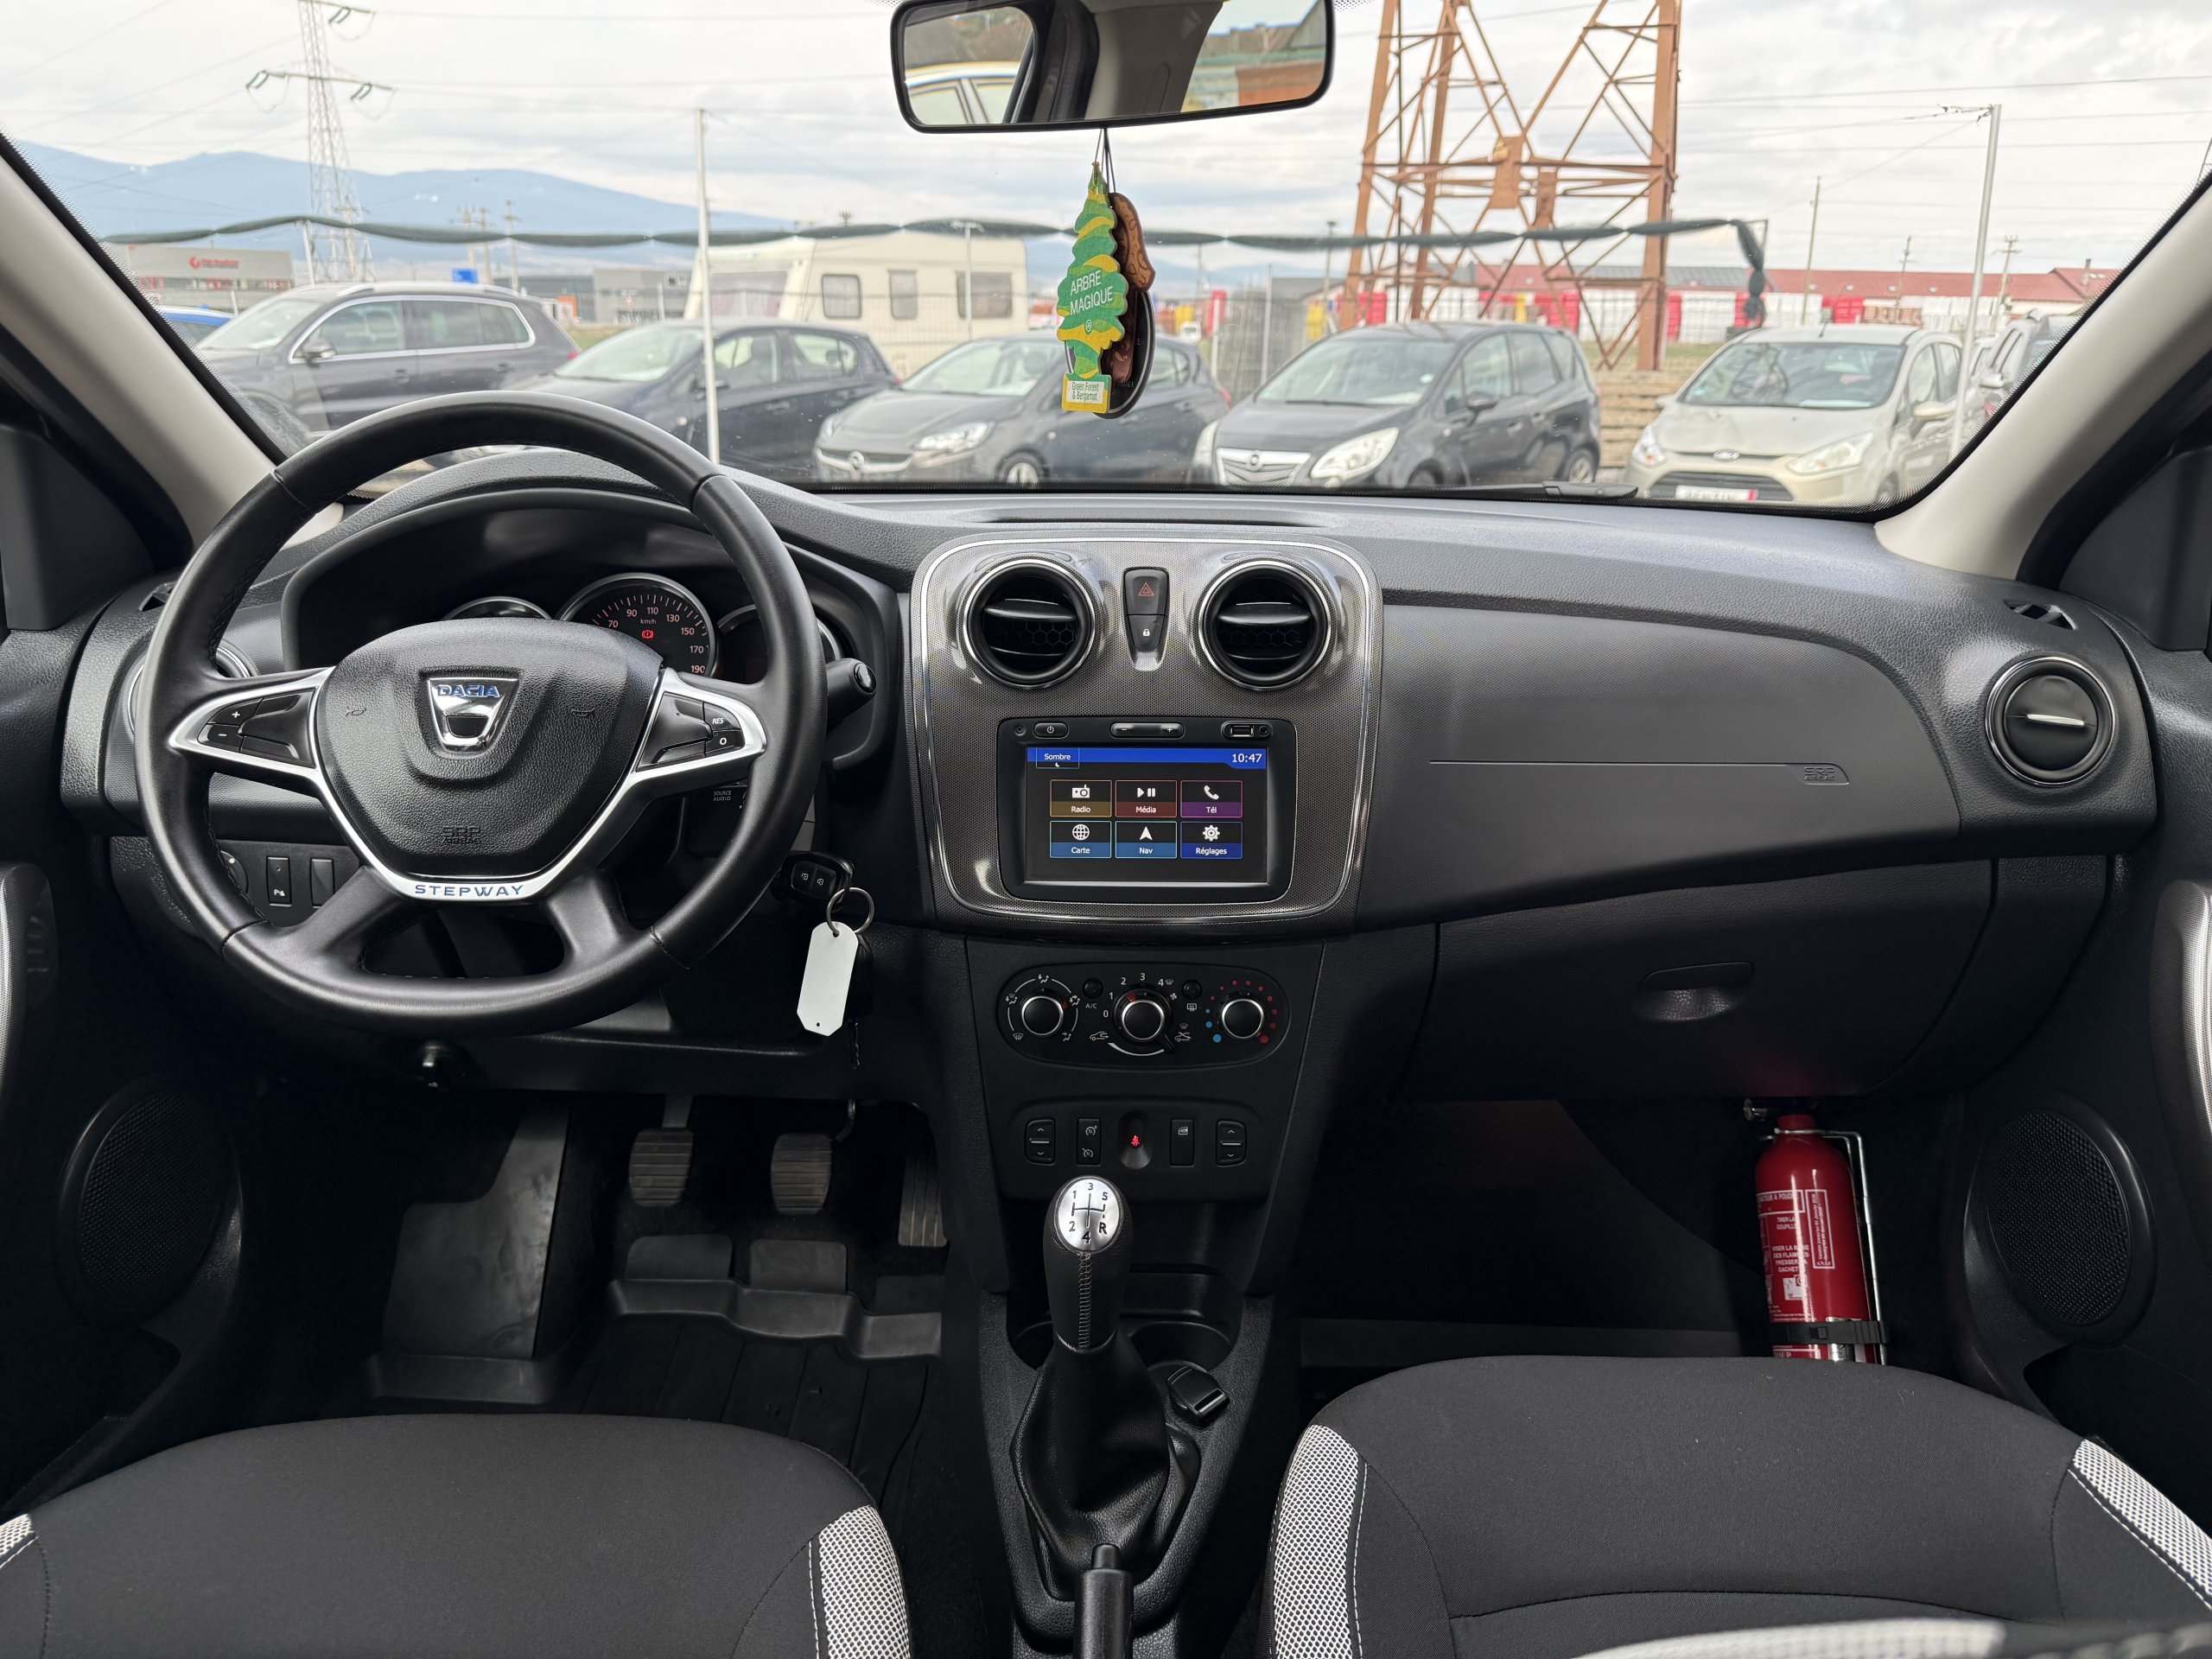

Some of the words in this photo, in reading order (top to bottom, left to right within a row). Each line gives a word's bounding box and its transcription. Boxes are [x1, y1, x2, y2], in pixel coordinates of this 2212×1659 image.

[1070, 270, 1102, 296] ARBRE
[1070, 286, 1114, 316] MAGIQUE
[1071, 382, 1084, 392] Green
[1085, 383, 1099, 392] Forest
[1076, 391, 1097, 402] Bergamot
[626, 608, 638, 618] 90
[646, 607, 659, 615] 110
[666, 613, 680, 623] 130
[608, 620, 619, 628] 70
[681, 626, 695, 636] 150
[690, 645, 704, 654] 170
[690, 664, 706, 674] 190
[437, 684, 500, 698] DACIA
[1231, 753, 1262, 764] 10:47
[1195, 847, 1228, 855] Réglages
[415, 884, 524, 897] STEPWAY
[1140, 972, 1146, 981] 3
[1109, 991, 1114, 1001] 1
[1103, 1009, 1109, 1018] 0
[1088, 1182, 1094, 1191] 3
[1072, 1190, 1077, 1199] 1
[1102, 1192, 1109, 1201] 5
[1069, 1220, 1076, 1232] 2
[1098, 1221, 1108, 1235] R
[1082, 1230, 1091, 1244] 4
